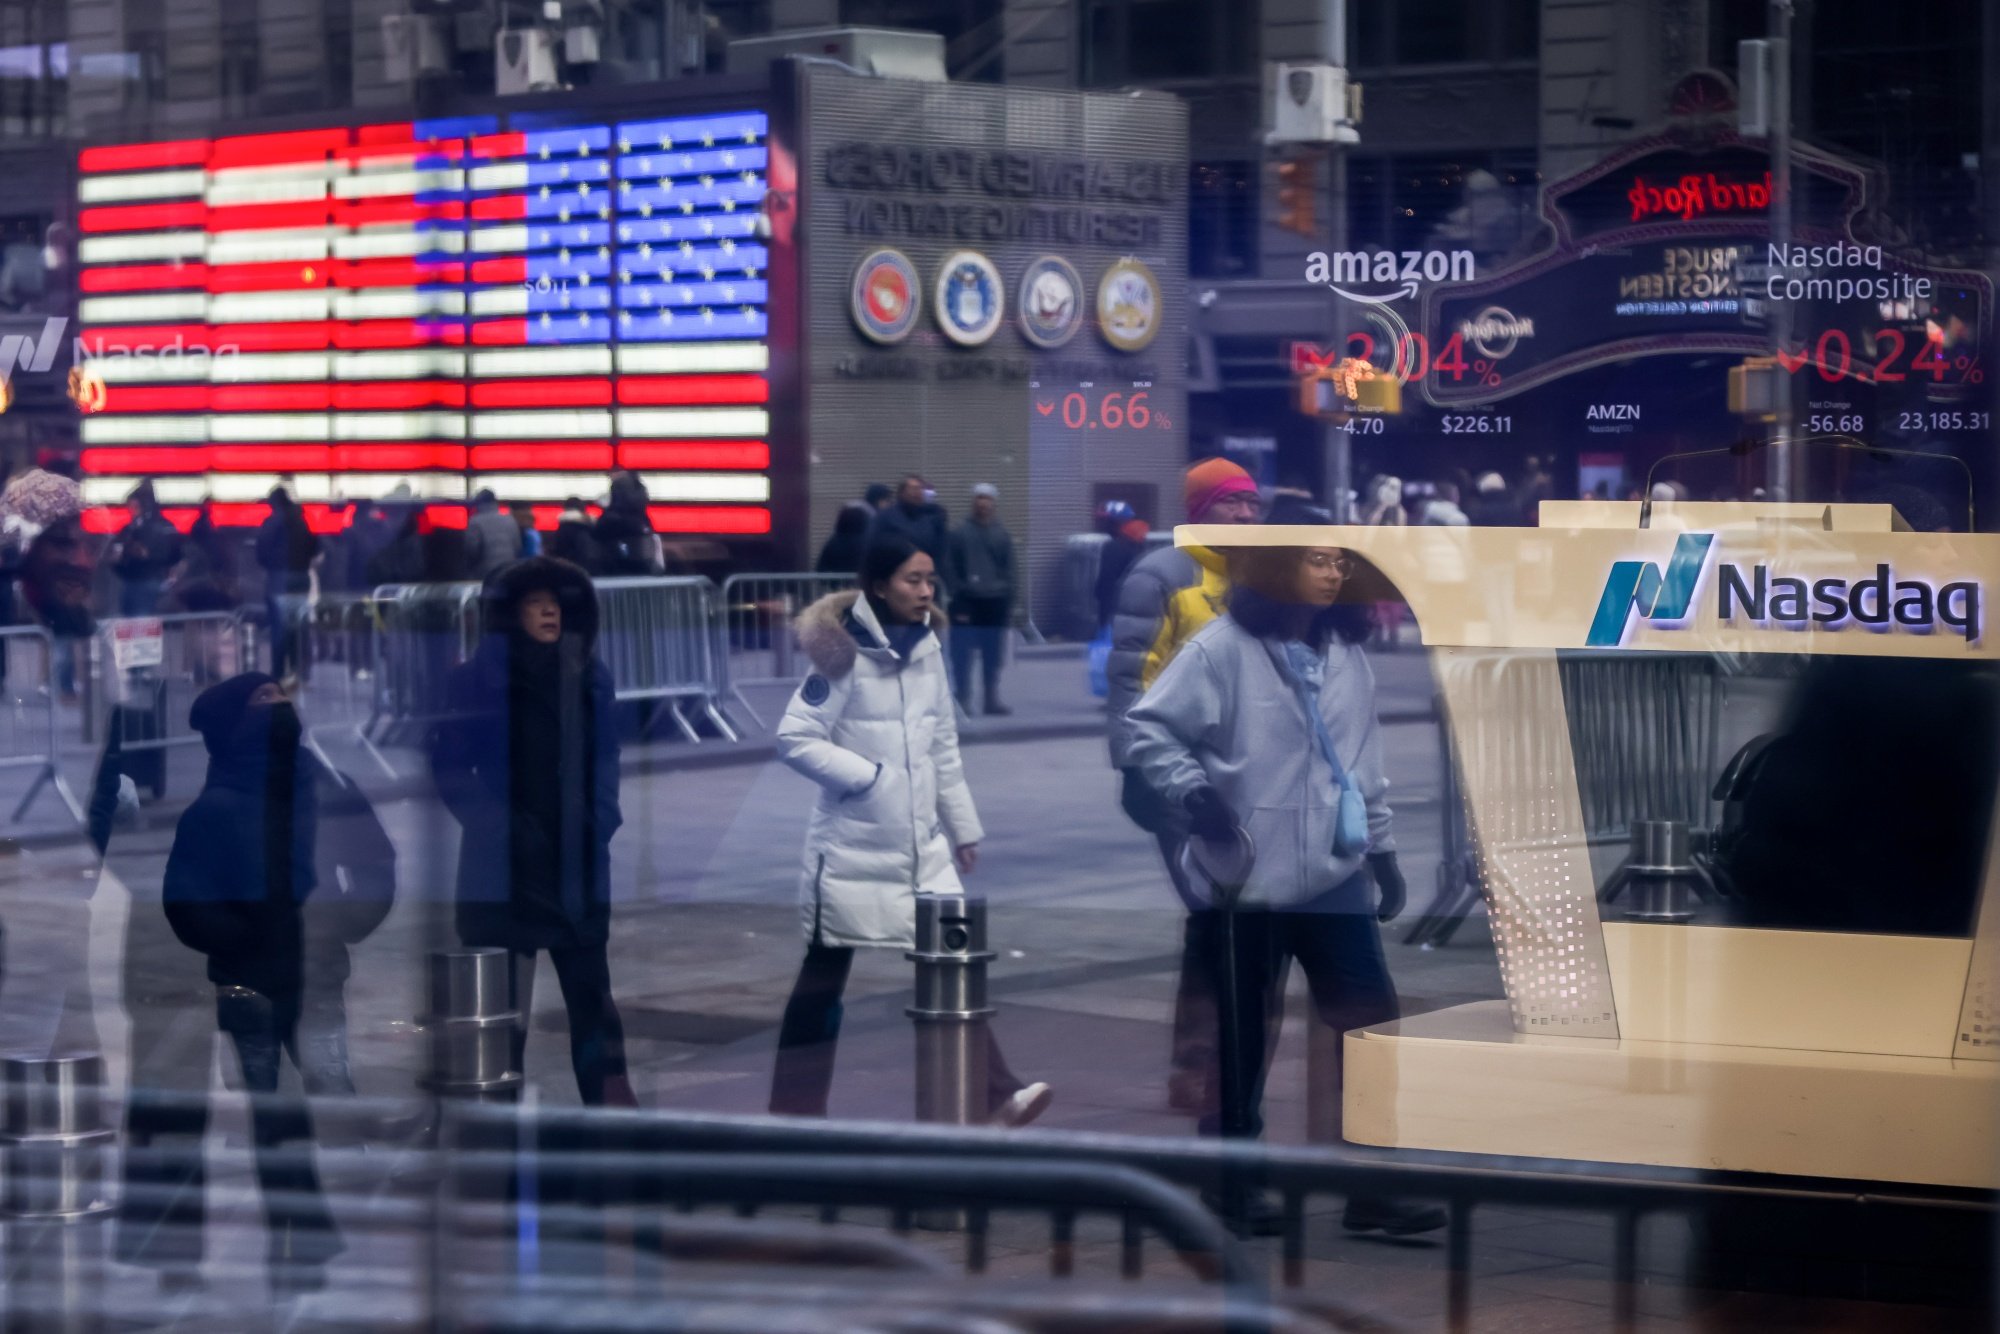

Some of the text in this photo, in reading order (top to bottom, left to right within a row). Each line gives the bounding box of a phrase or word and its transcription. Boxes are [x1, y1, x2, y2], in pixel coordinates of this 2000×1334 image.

[1768, 240, 1882, 271] Nasdaq
[1305, 250, 1475, 283] amazon
[1767, 272, 1931, 304] Composite
[73, 334, 240, 383] Nasdaq
[1586, 404, 1640, 420] AMZN
[1823, 400, 1852, 410] Change
[1335, 417, 1384, 435] -4.70
[1441, 414, 1512, 435] $226.11
[1801, 415, 1864, 433] -56.68
[1899, 412, 1990, 432] 23,185.31
[1717, 563, 1979, 642] Nasdaq
